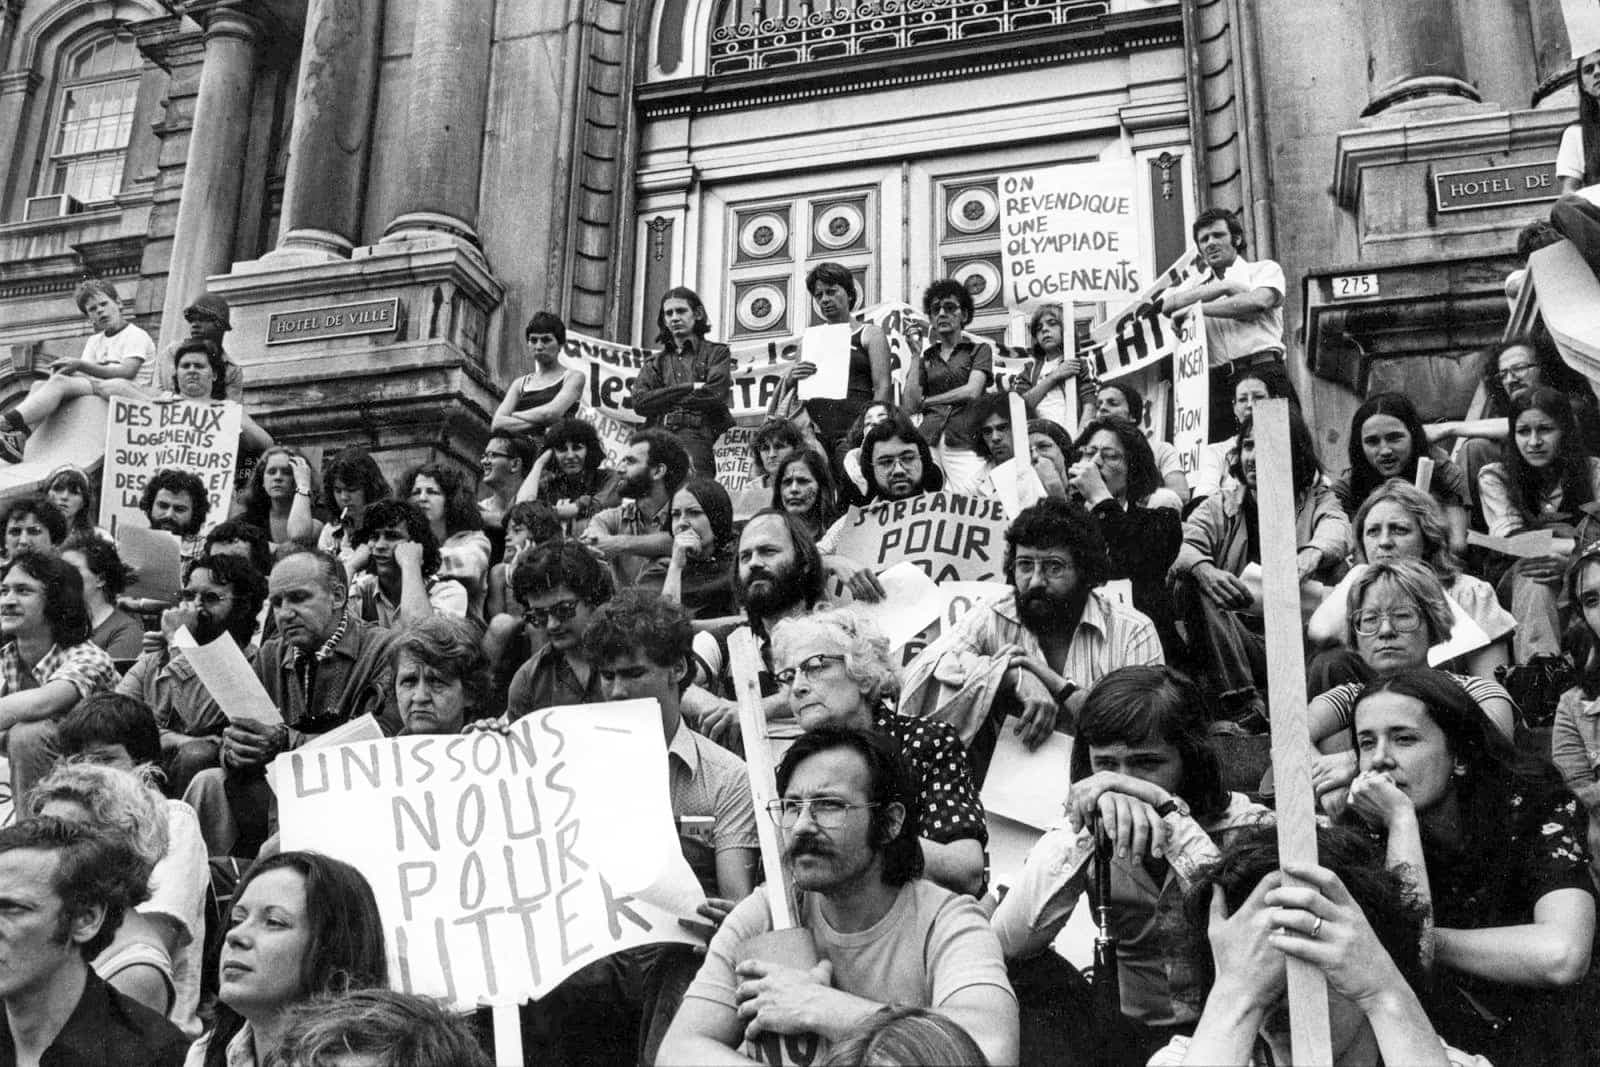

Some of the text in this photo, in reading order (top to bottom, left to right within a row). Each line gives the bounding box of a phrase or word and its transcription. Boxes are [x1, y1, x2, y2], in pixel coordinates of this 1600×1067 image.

[1004, 176, 1034, 194] ON
[1451, 174, 1551, 196] HOTEL DE
[1006, 192, 1129, 216] REVENDIQUE
[1008, 216, 1048, 236] UNE
[1007, 231, 1119, 256] OLYMPIADE
[1012, 259, 1036, 276] DE
[1014, 260, 1140, 304] LOGEMENTS
[1341, 276, 1370, 294] 275
[277, 309, 390, 333] HOTEL DE VILLE
[115, 402, 225, 431] DES BEAUX
[1175, 407, 1201, 433] TION
[127, 428, 215, 448] LOGEMENTS
[115, 473, 147, 490] DES
[209, 470, 232, 490] ET
[878, 519, 990, 563] POUR
[391, 761, 576, 852] NOUS
[398, 819, 589, 920] POUR
